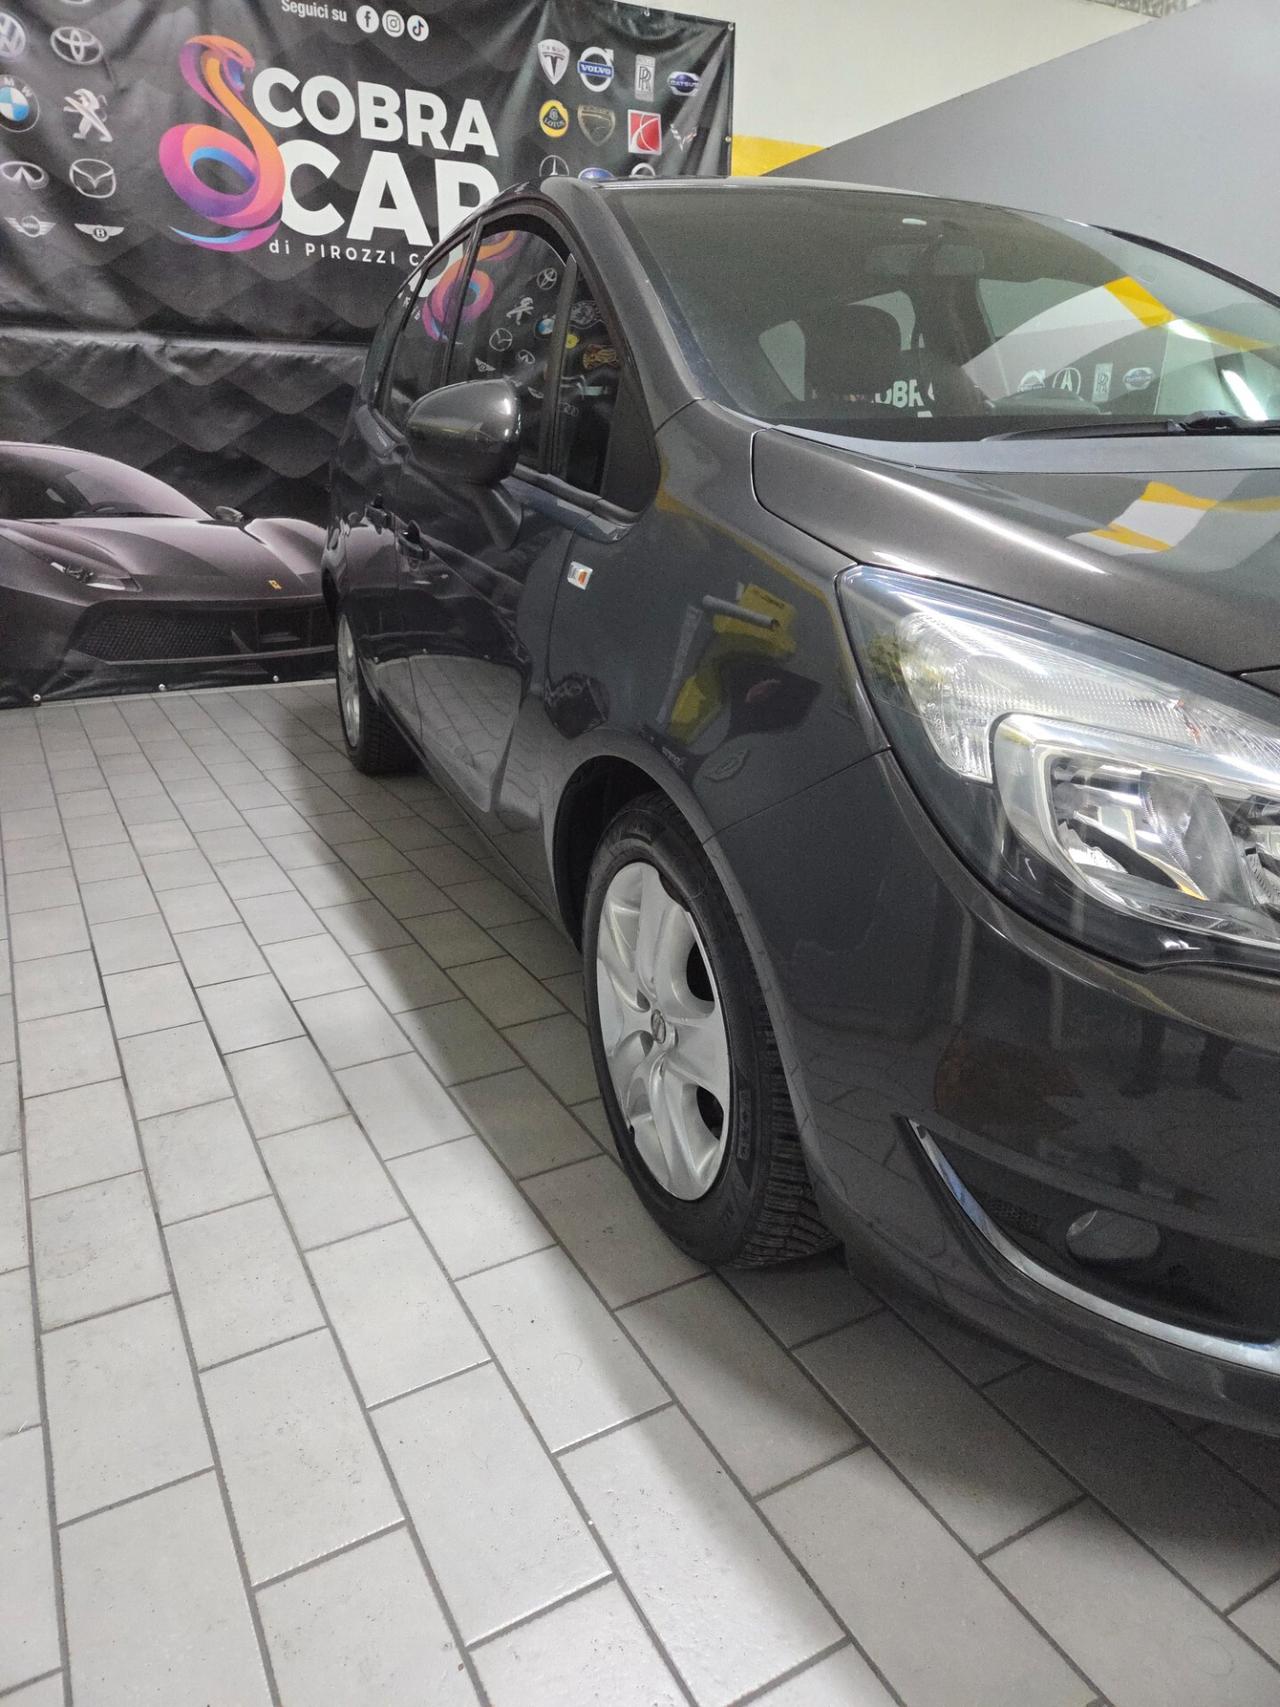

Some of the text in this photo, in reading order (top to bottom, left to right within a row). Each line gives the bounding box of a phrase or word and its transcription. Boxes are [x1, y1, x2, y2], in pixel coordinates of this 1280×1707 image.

[281, 0, 347, 23] Seguici su
[580, 64, 611, 75] VOLVO
[252, 67, 500, 157] COBRA
[269, 239, 290, 255] di
[305, 243, 396, 265] PIROZZI
